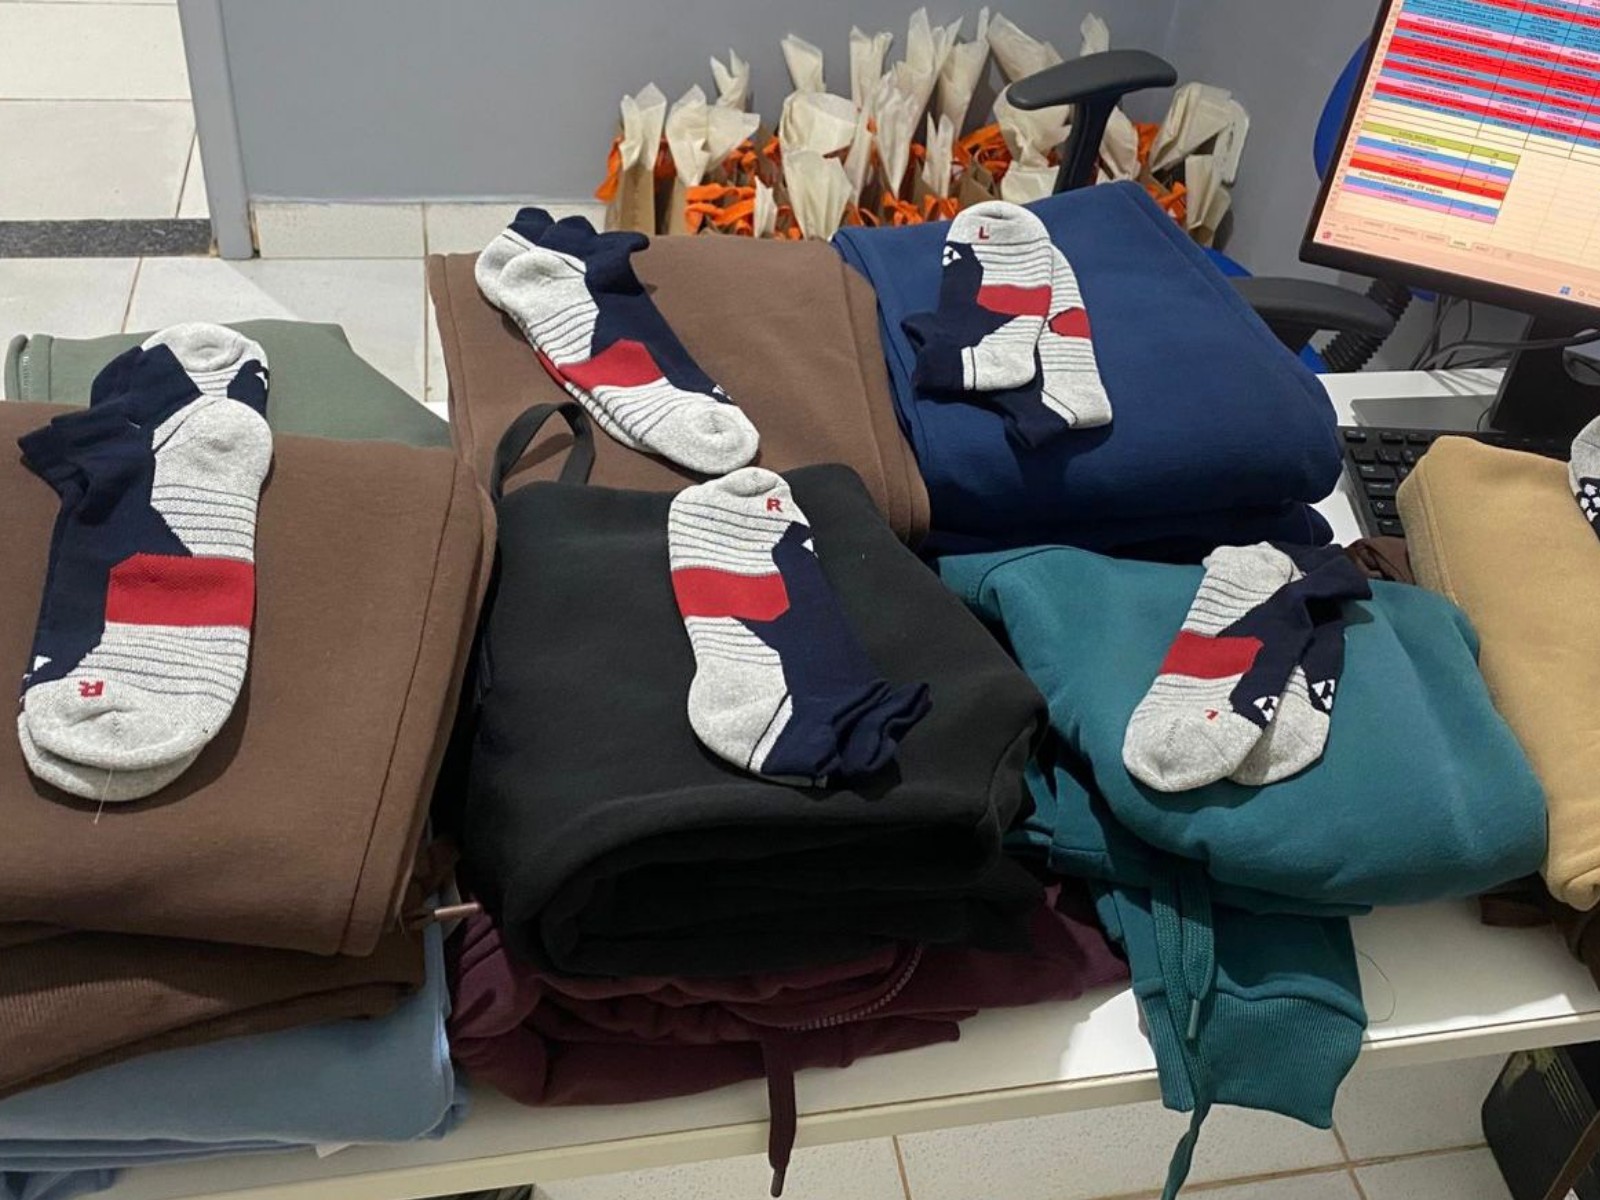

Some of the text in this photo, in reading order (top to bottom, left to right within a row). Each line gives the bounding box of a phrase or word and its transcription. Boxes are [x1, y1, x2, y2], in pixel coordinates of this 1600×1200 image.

[979, 225, 990, 240] L
[766, 497, 784, 513] R
[78, 680, 104, 698] R
